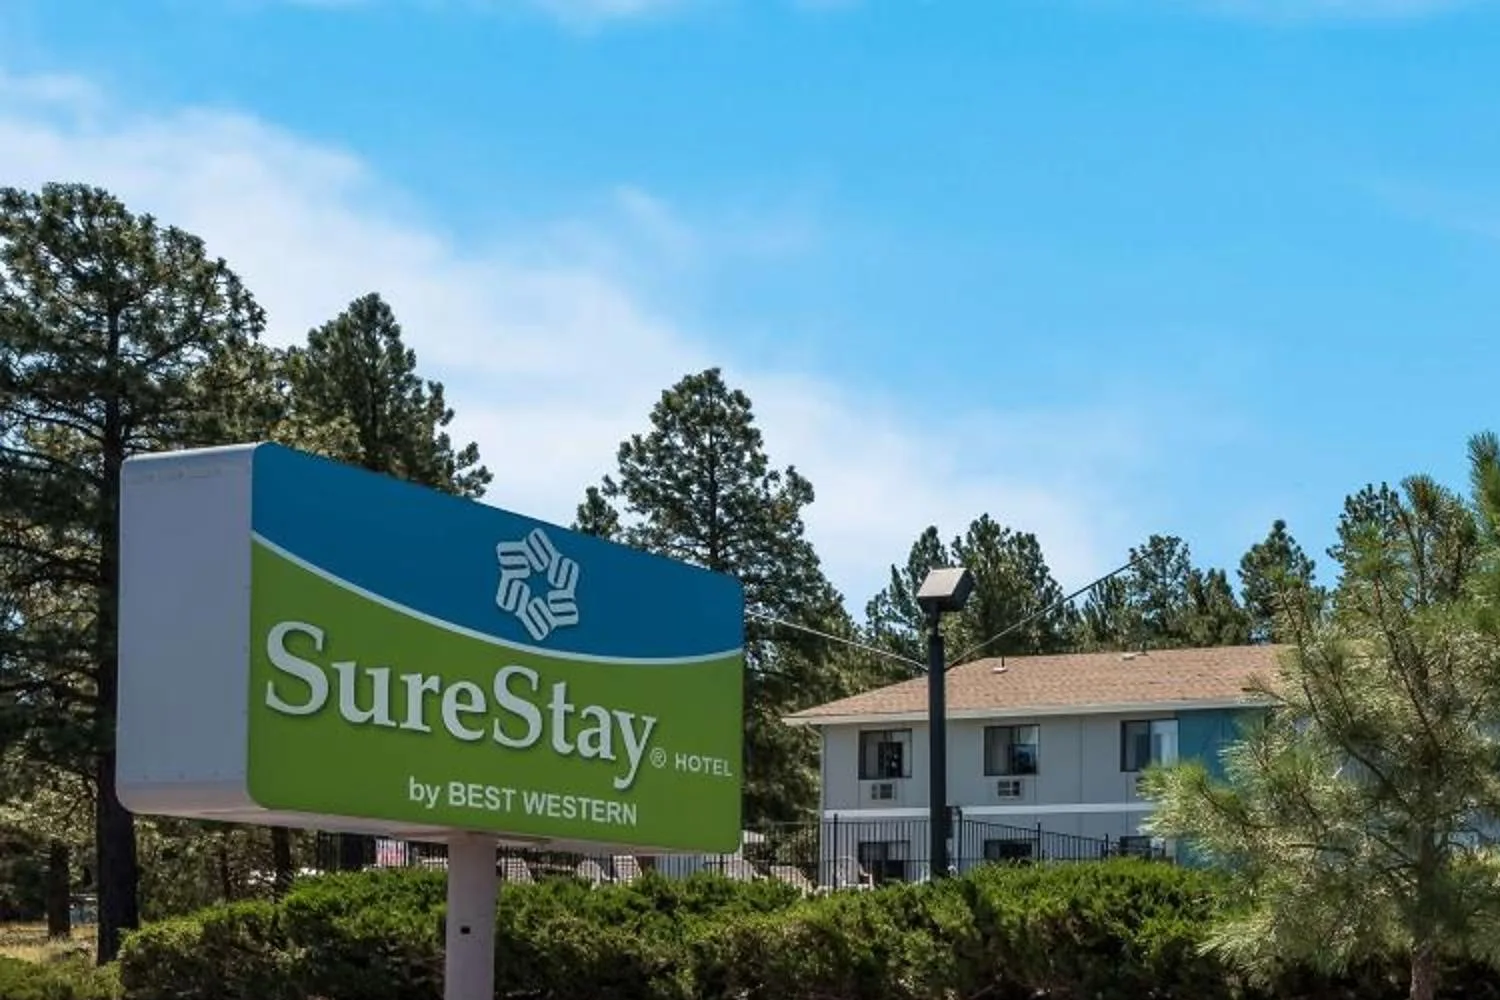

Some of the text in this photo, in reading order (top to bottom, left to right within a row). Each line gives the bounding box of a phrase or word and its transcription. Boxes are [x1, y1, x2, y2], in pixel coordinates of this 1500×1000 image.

[675, 754, 733, 778] HOTEL
[409, 776, 637, 826] by BEST WESTERN
